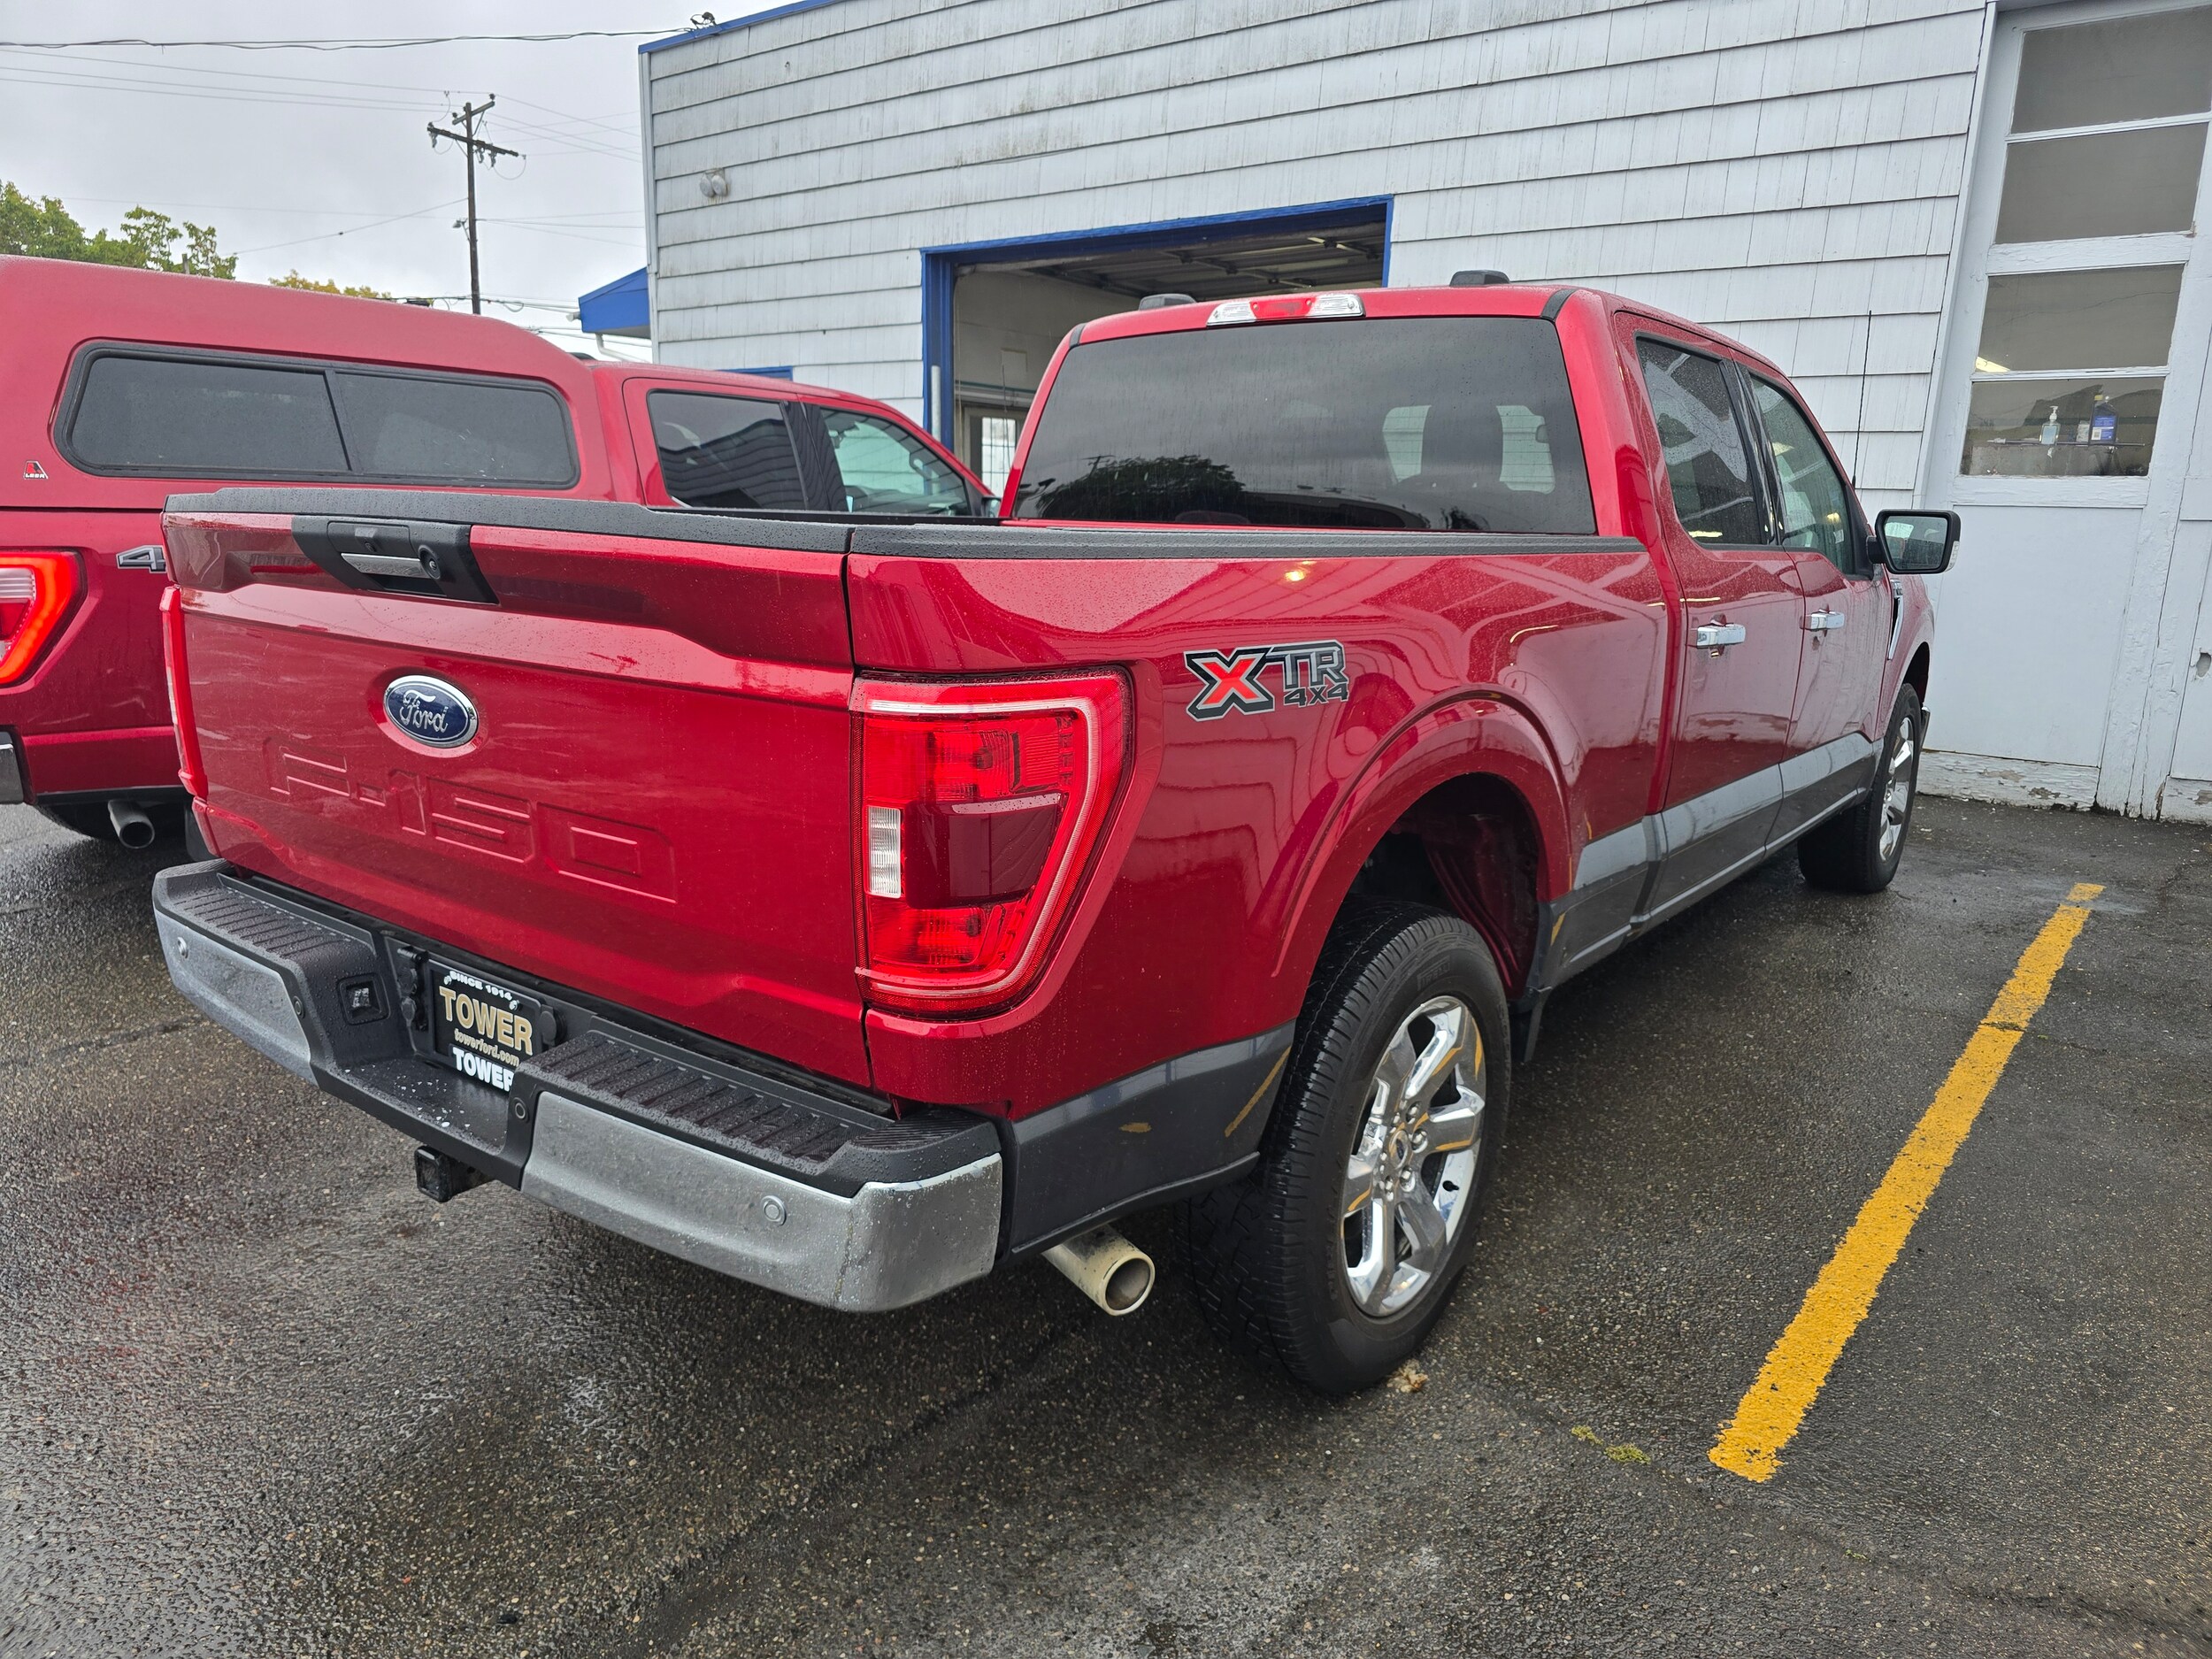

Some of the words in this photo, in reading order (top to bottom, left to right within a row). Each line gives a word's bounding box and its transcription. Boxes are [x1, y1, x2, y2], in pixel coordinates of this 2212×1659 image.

[399, 689, 449, 733] Ford
[264, 735, 678, 903] F-150
[449, 970, 483, 990] SINCE
[439, 986, 534, 1056] TOWER
[454, 1027, 520, 1068] towerford.com
